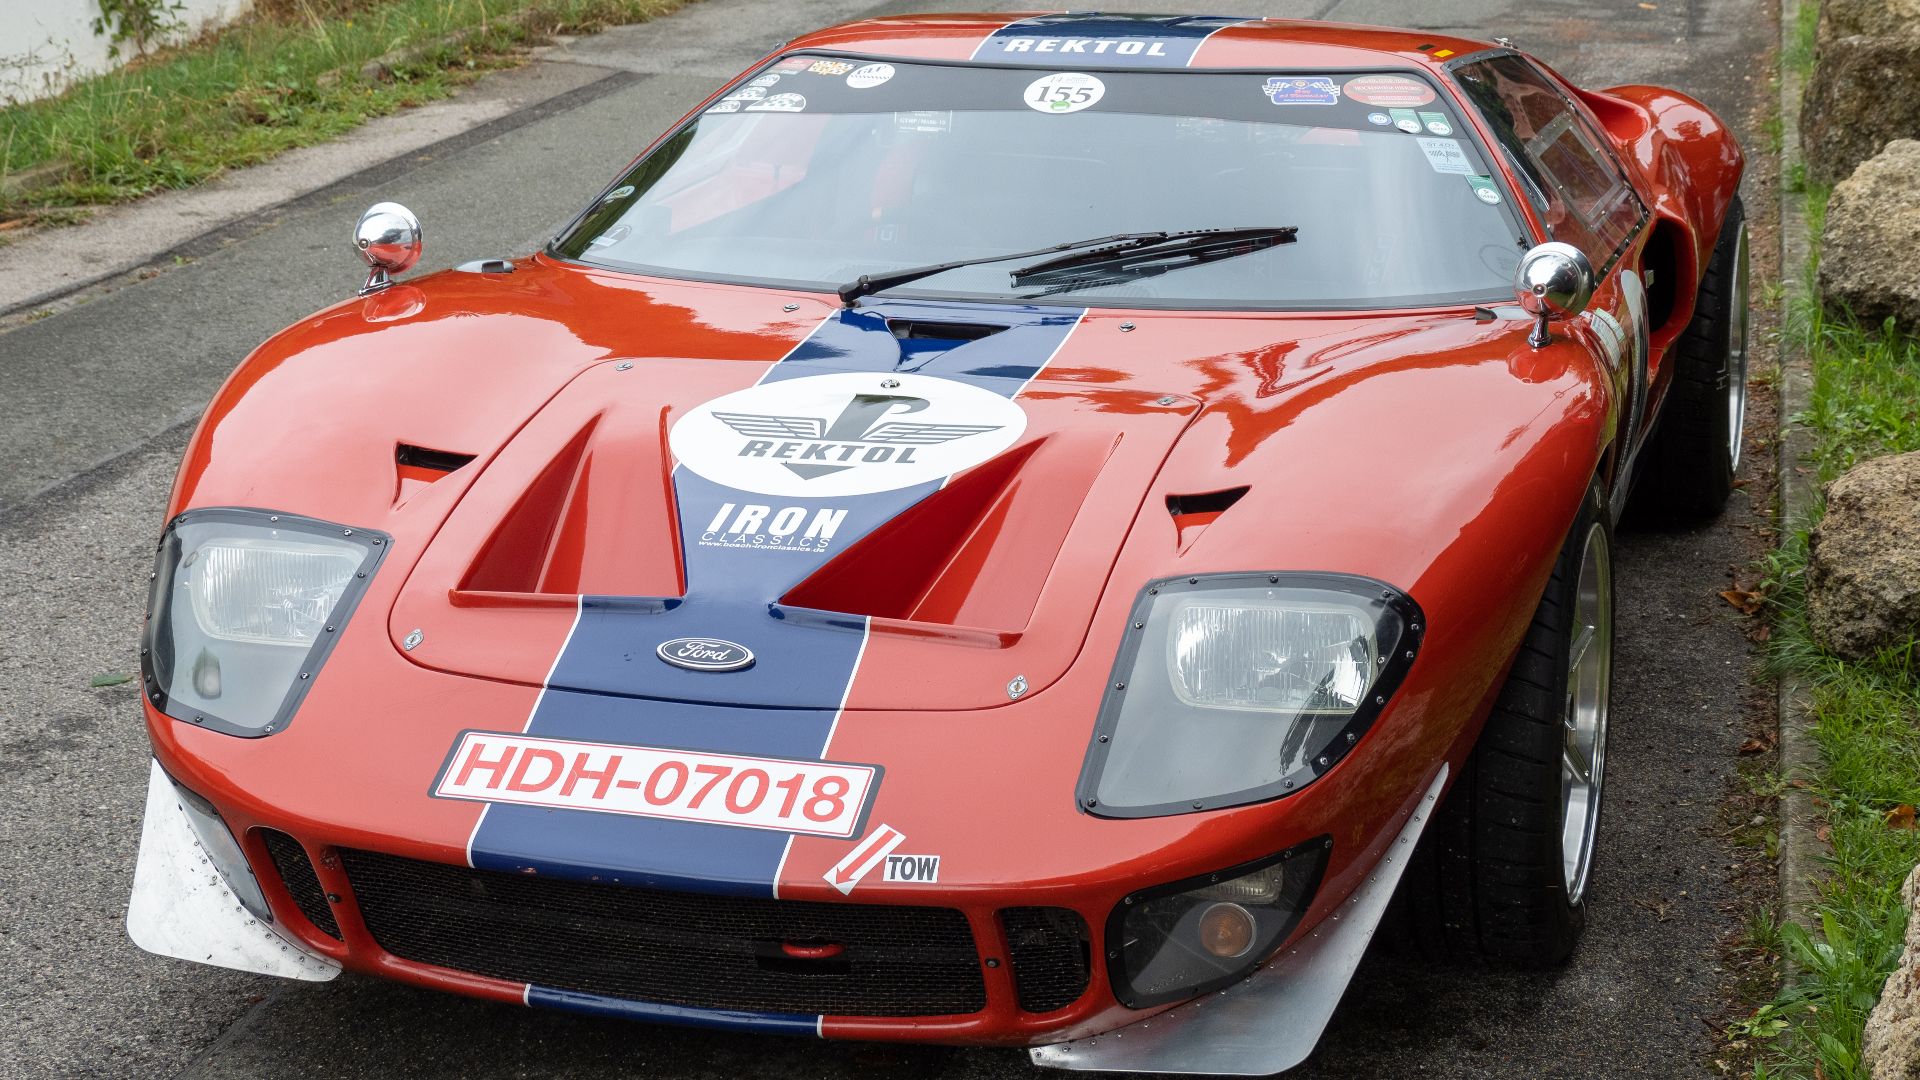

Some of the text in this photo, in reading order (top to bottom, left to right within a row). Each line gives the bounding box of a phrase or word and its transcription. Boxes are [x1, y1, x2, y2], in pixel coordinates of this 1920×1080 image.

[1004, 39, 1167, 57] REKTOL
[1034, 85, 1095, 104] 155
[737, 440, 917, 465] REKTOL
[706, 502, 849, 539] IRON
[698, 541, 826, 553] www.bosch-ironclassics.de
[701, 531, 831, 548] CLASSICS
[677, 641, 732, 661] Ford
[453, 741, 851, 823] HDH-07018
[887, 855, 939, 882] TOW
